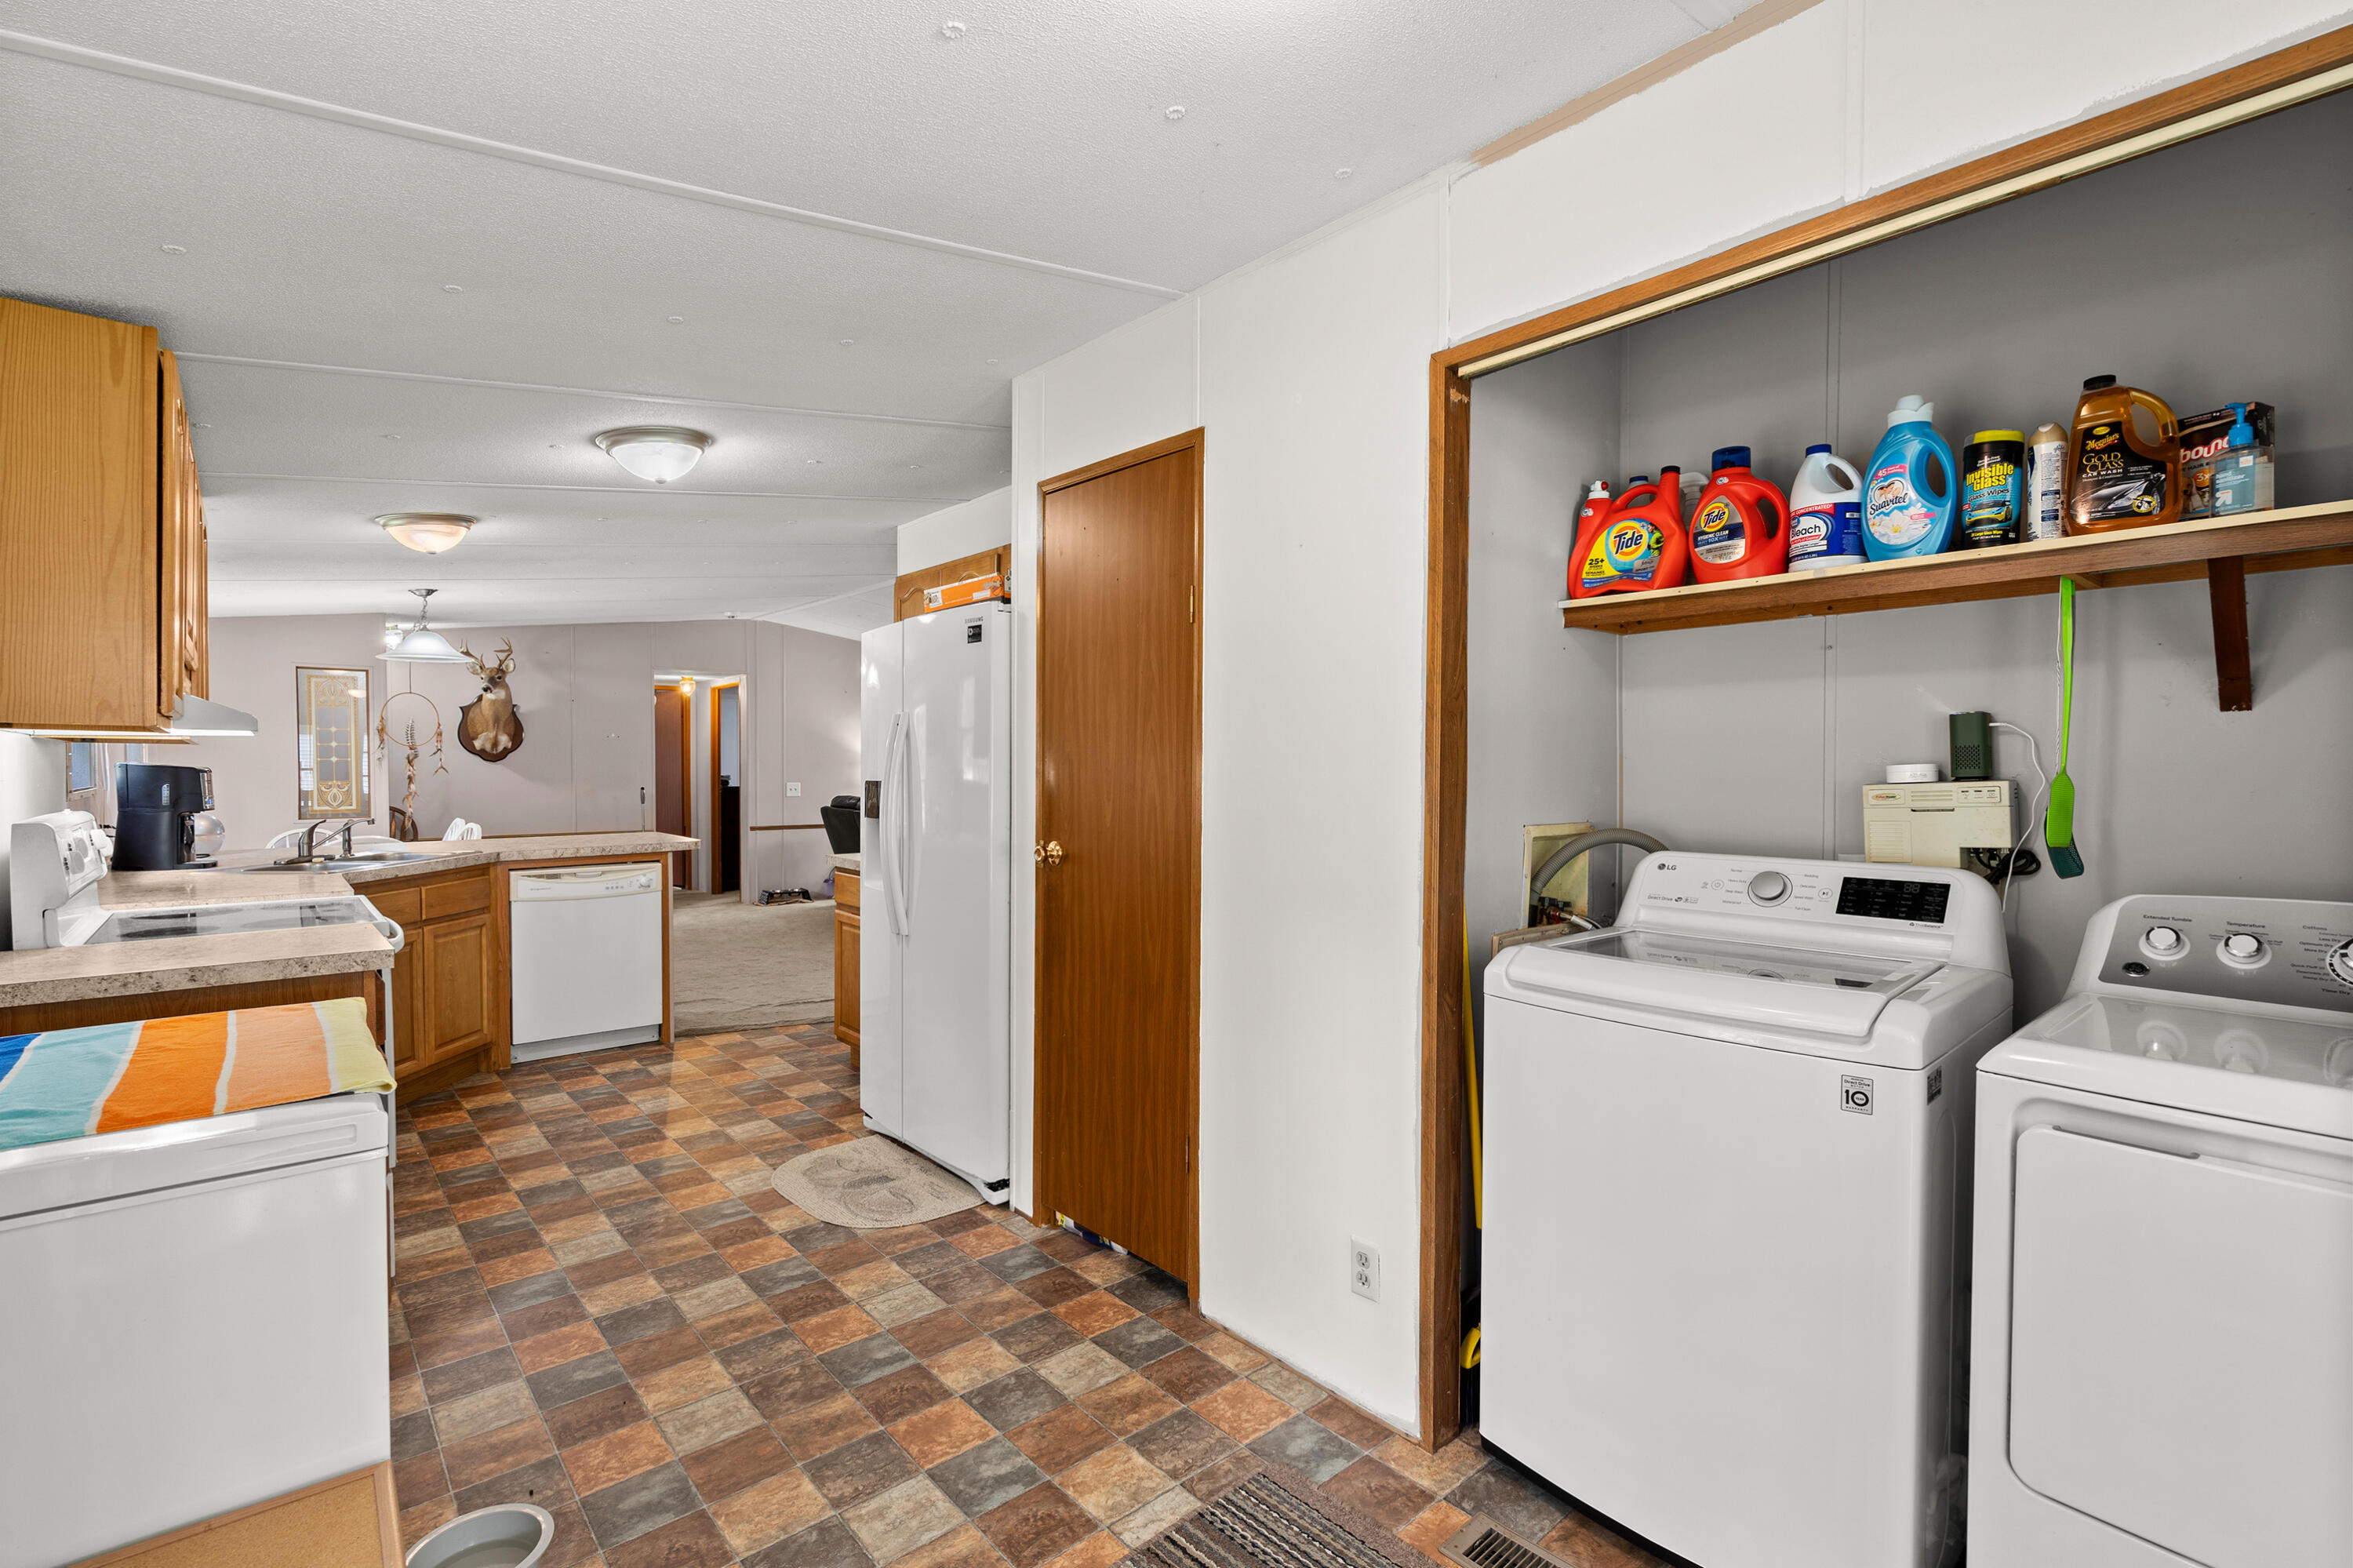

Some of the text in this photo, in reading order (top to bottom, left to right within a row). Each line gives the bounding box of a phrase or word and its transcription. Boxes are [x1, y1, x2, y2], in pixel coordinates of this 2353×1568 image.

[2086, 432, 2120, 451] Meguiar's
[2082, 452, 2121, 465] GOLD
[2086, 459, 2124, 474] CLASS
[1966, 462, 2014, 486] Invisible
[1973, 475, 2006, 492] Glass
[1968, 488, 2009, 503] Glass Wipes
[1869, 493, 1908, 516] Suavitel
[1702, 508, 1726, 529] Tide
[1791, 523, 1821, 539] Bleach
[1613, 529, 1644, 555] Tide
[1587, 557, 1606, 566] 25+
[1844, 1089, 1870, 1107] 10
